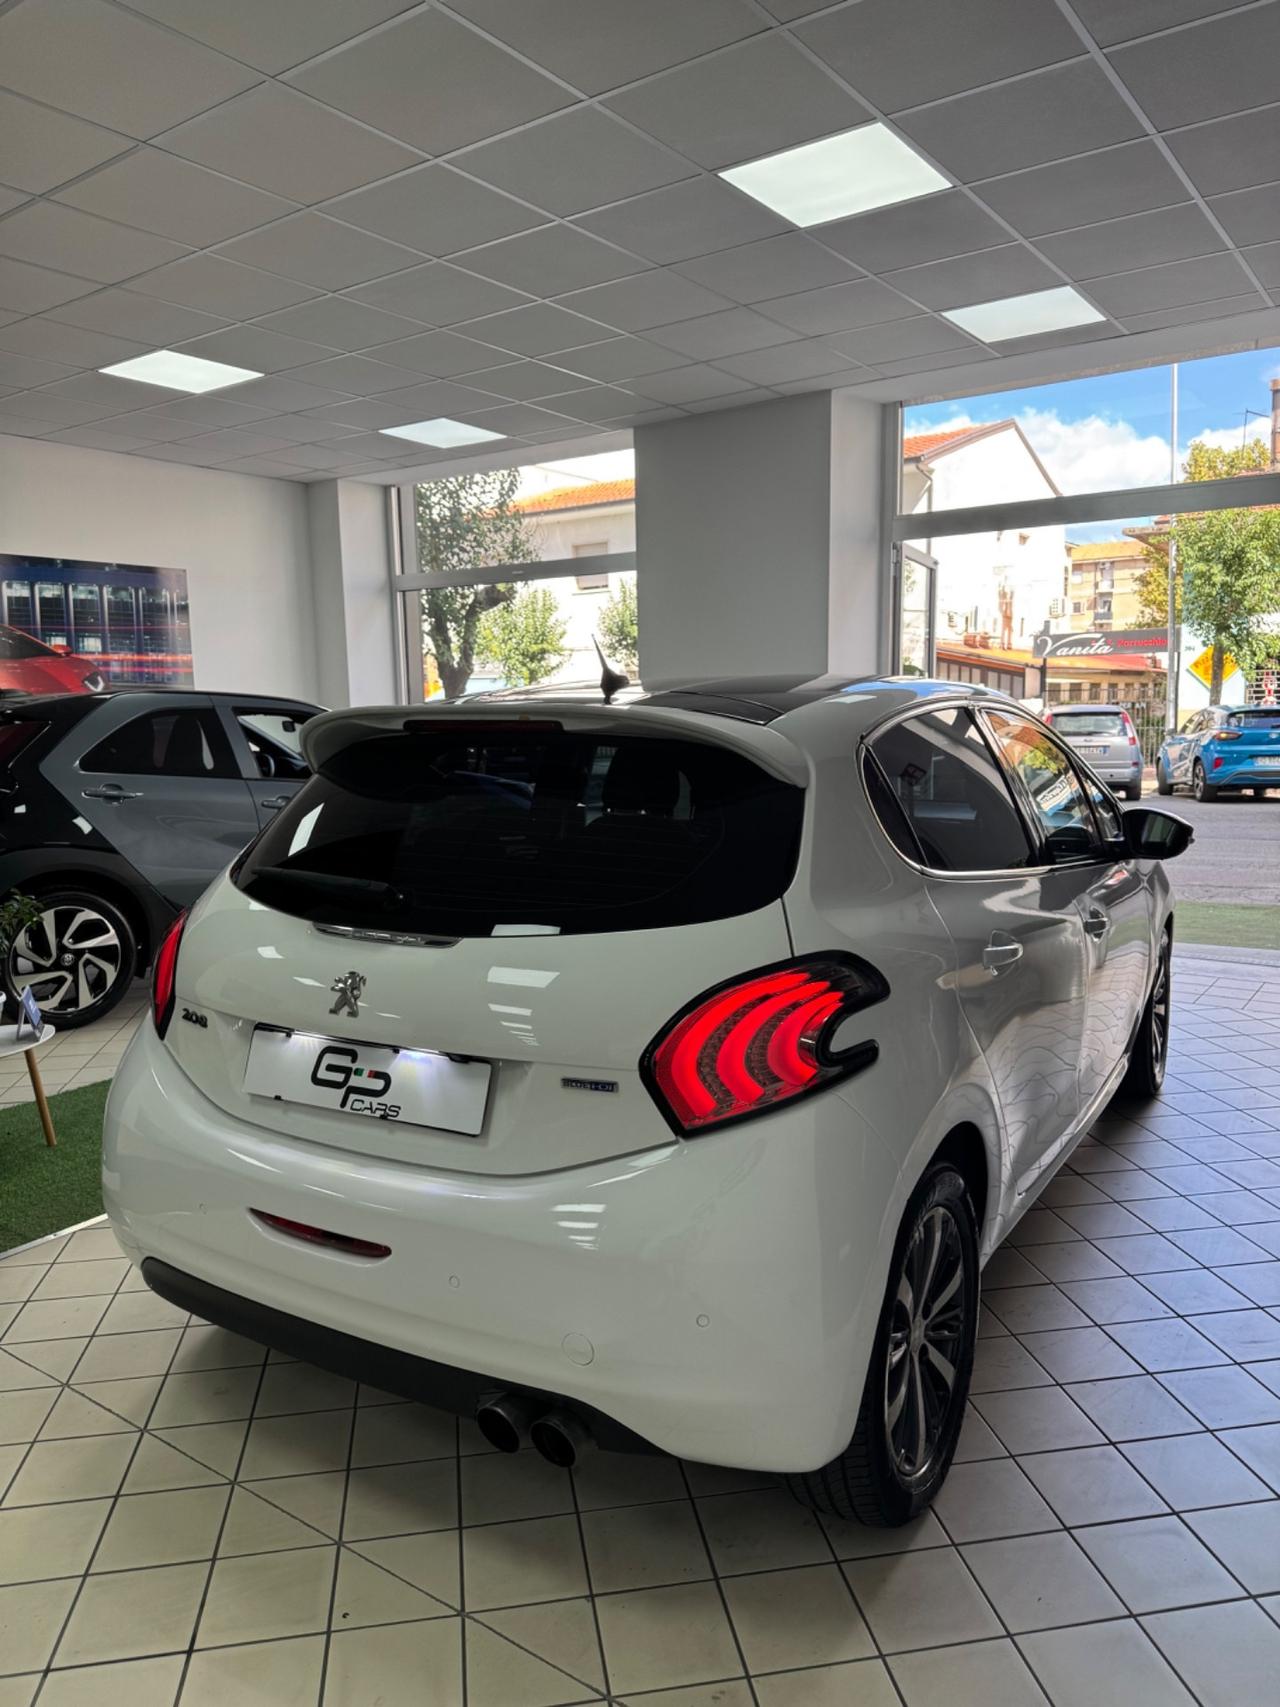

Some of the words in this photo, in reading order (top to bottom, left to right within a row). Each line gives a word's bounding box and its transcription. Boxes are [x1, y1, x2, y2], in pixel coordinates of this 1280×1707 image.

[182, 1008, 208, 1029] 208
[311, 1045, 392, 1109] GP
[350, 1098, 401, 1118] CARS
